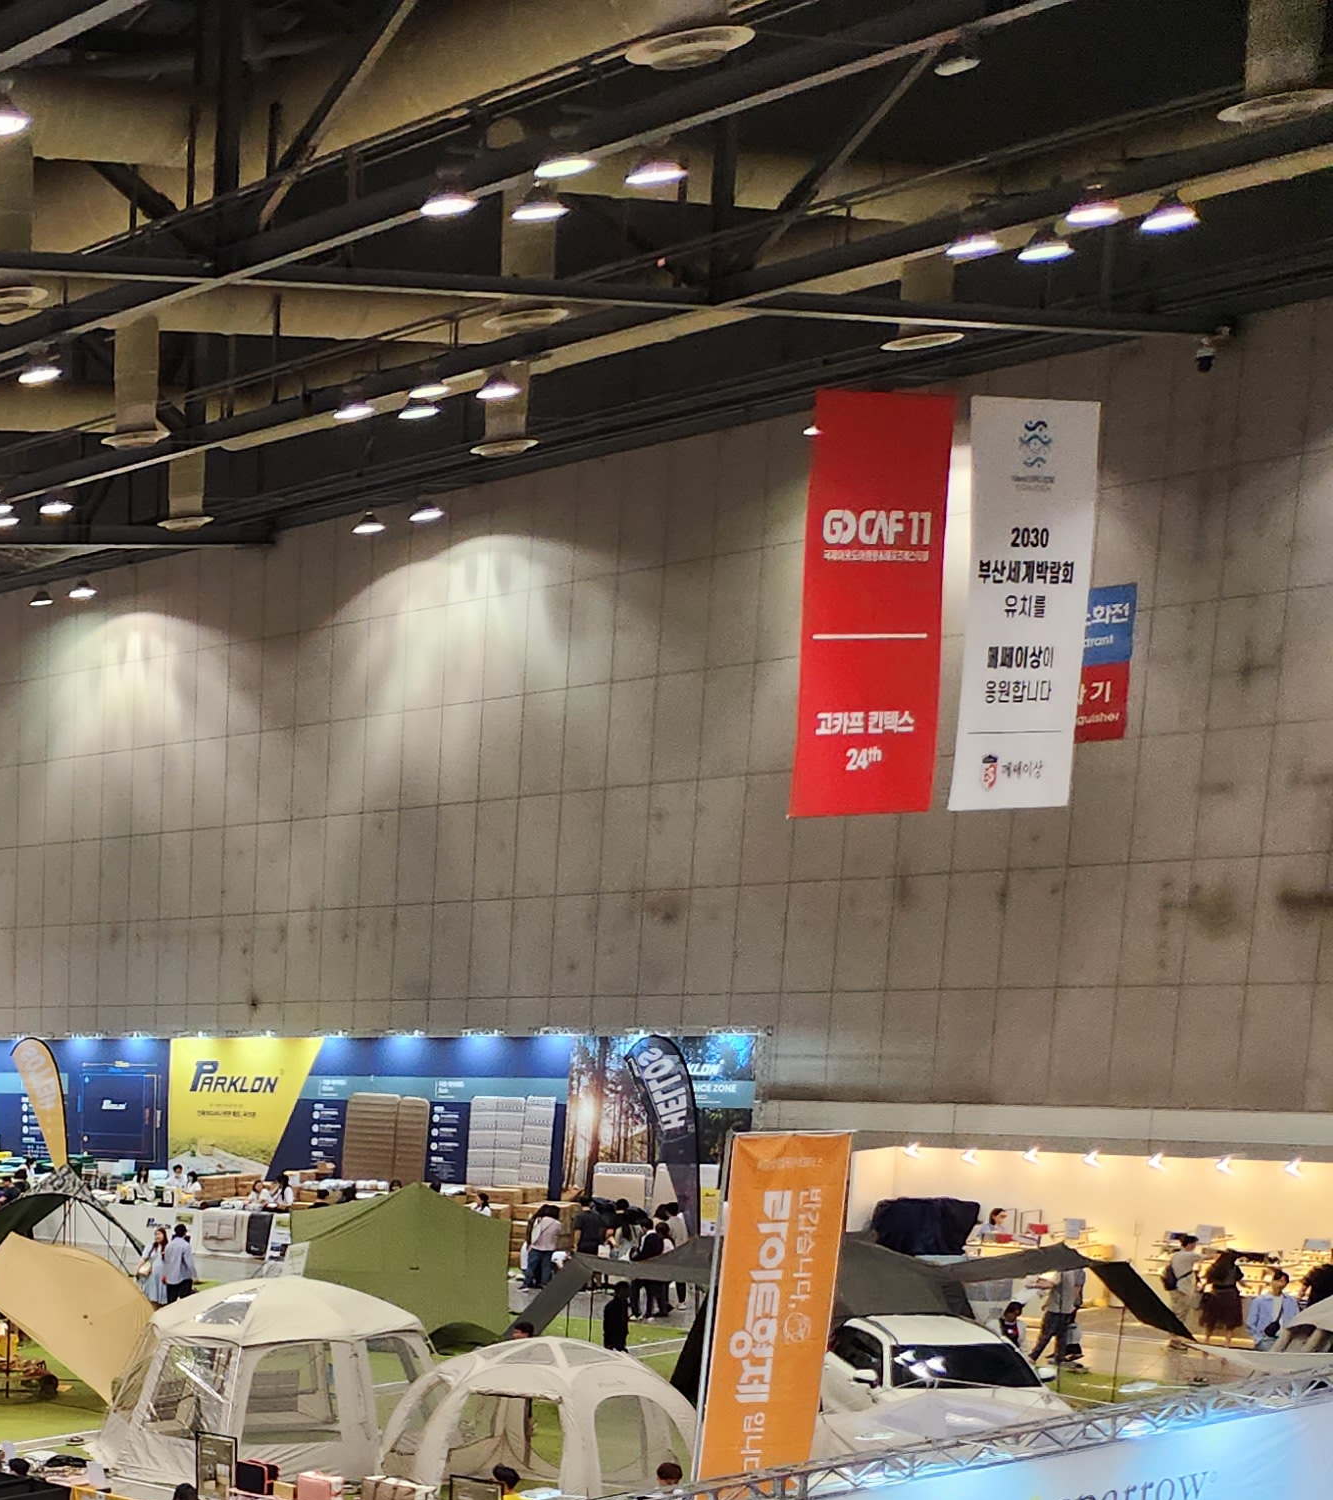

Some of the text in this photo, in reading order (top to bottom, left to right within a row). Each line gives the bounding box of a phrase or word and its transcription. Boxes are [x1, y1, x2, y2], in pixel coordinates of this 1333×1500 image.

[1011, 527, 1049, 548] 2030
[978, 559, 1073, 585] 부산세계박람회
[1004, 594, 1046, 619] 유치를
[984, 679, 1052, 704] 응원합니다
[815, 711, 915, 735] 고카프 킨텍스
[846, 746, 882, 771] 24th
[189, 1060, 278, 1095] PARKLON
[713, 1084, 736, 1092] ZONE
[789, 1188, 822, 1311] 반갑습니다,
[730, 1191, 792, 1404] 라이트형제
